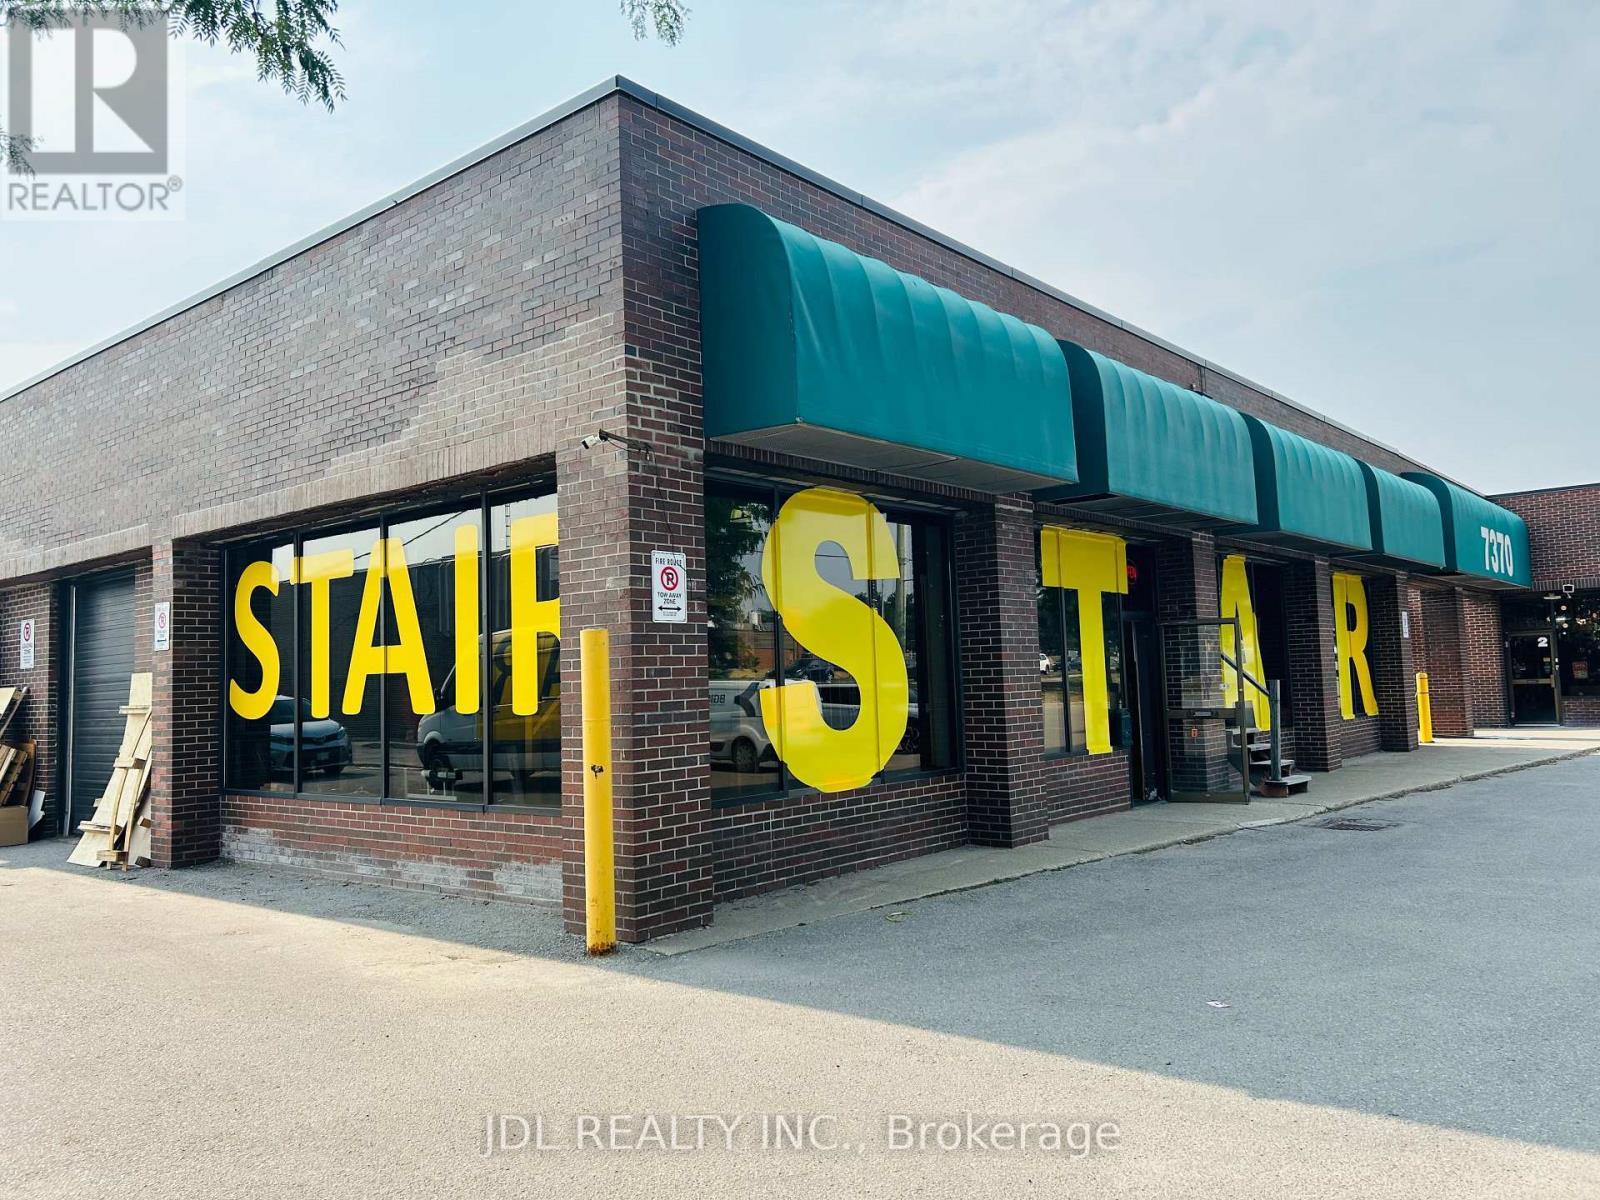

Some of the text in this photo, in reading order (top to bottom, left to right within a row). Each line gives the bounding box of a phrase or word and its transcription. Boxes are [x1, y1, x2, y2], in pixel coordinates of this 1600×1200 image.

[1480, 526, 1514, 577] 7370
[655, 557, 666, 565] FIRE
[1537, 636, 1548, 648] 2
